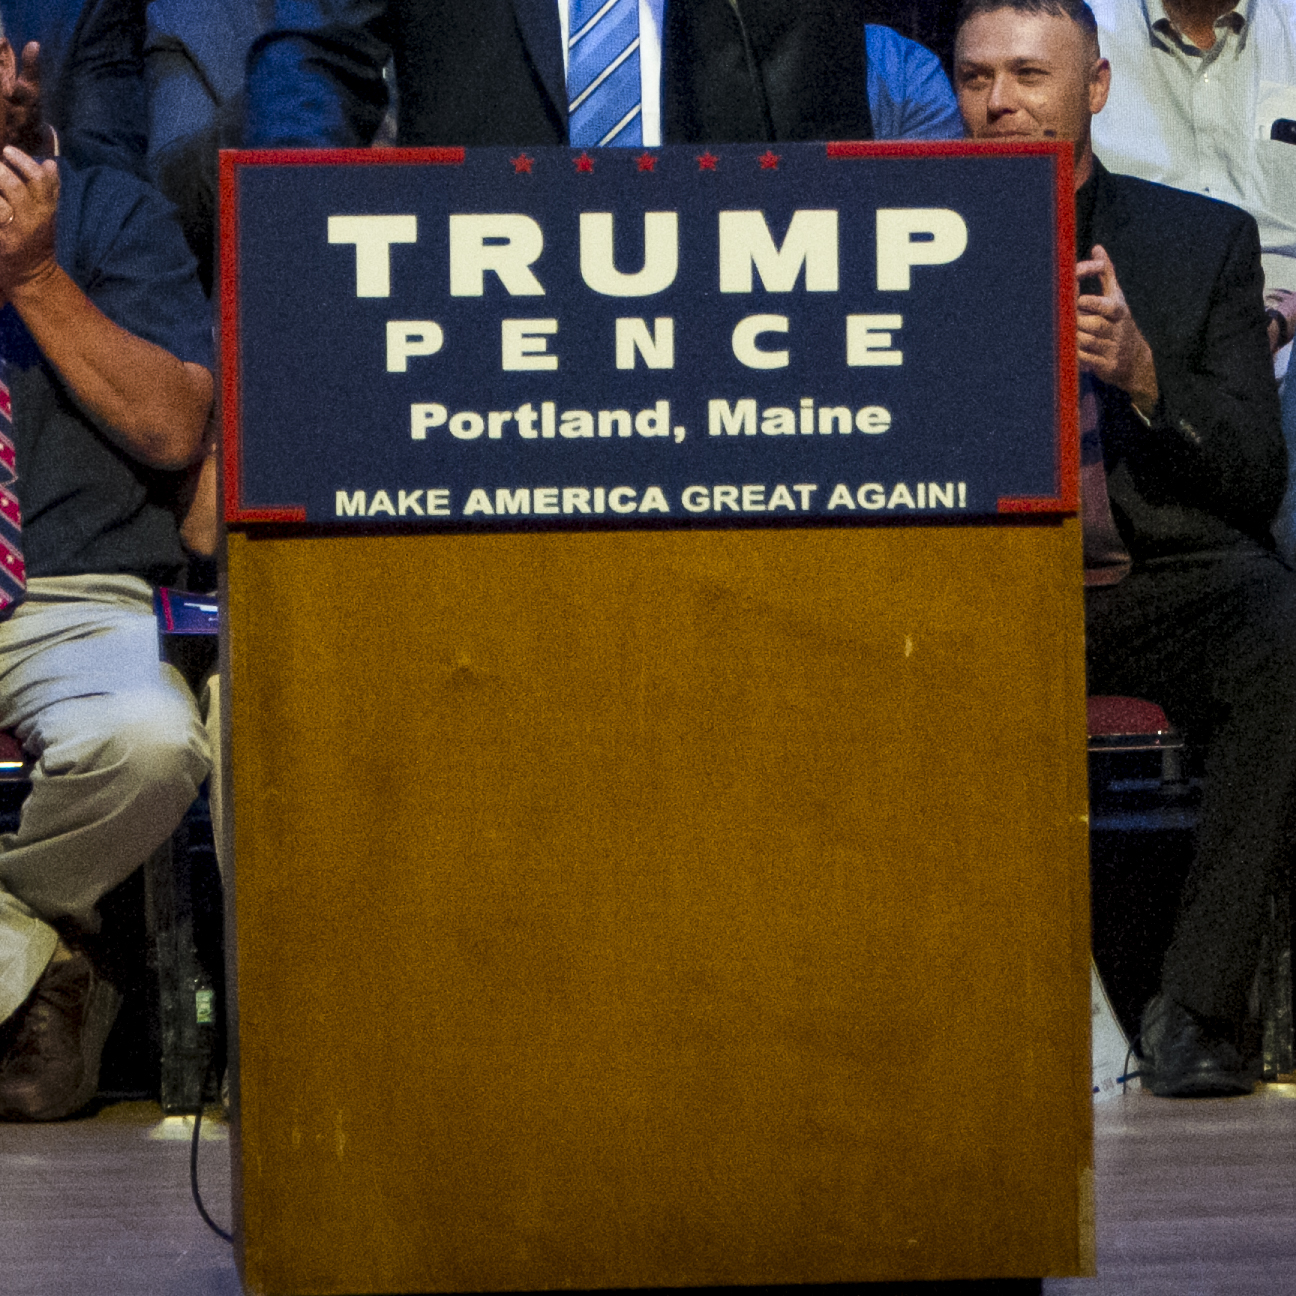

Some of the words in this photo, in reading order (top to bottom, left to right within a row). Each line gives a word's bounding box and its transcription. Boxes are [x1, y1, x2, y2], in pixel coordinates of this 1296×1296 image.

[327, 207, 968, 298] TRUMP
[385, 313, 903, 373] PENCE
[410, 399, 686, 444] Portland,
[708, 397, 892, 436] Maine
[335, 489, 451, 517] MAKE
[463, 486, 670, 516] AMERICA
[681, 484, 818, 513] GREAT
[827, 482, 967, 510] AGAIN!
